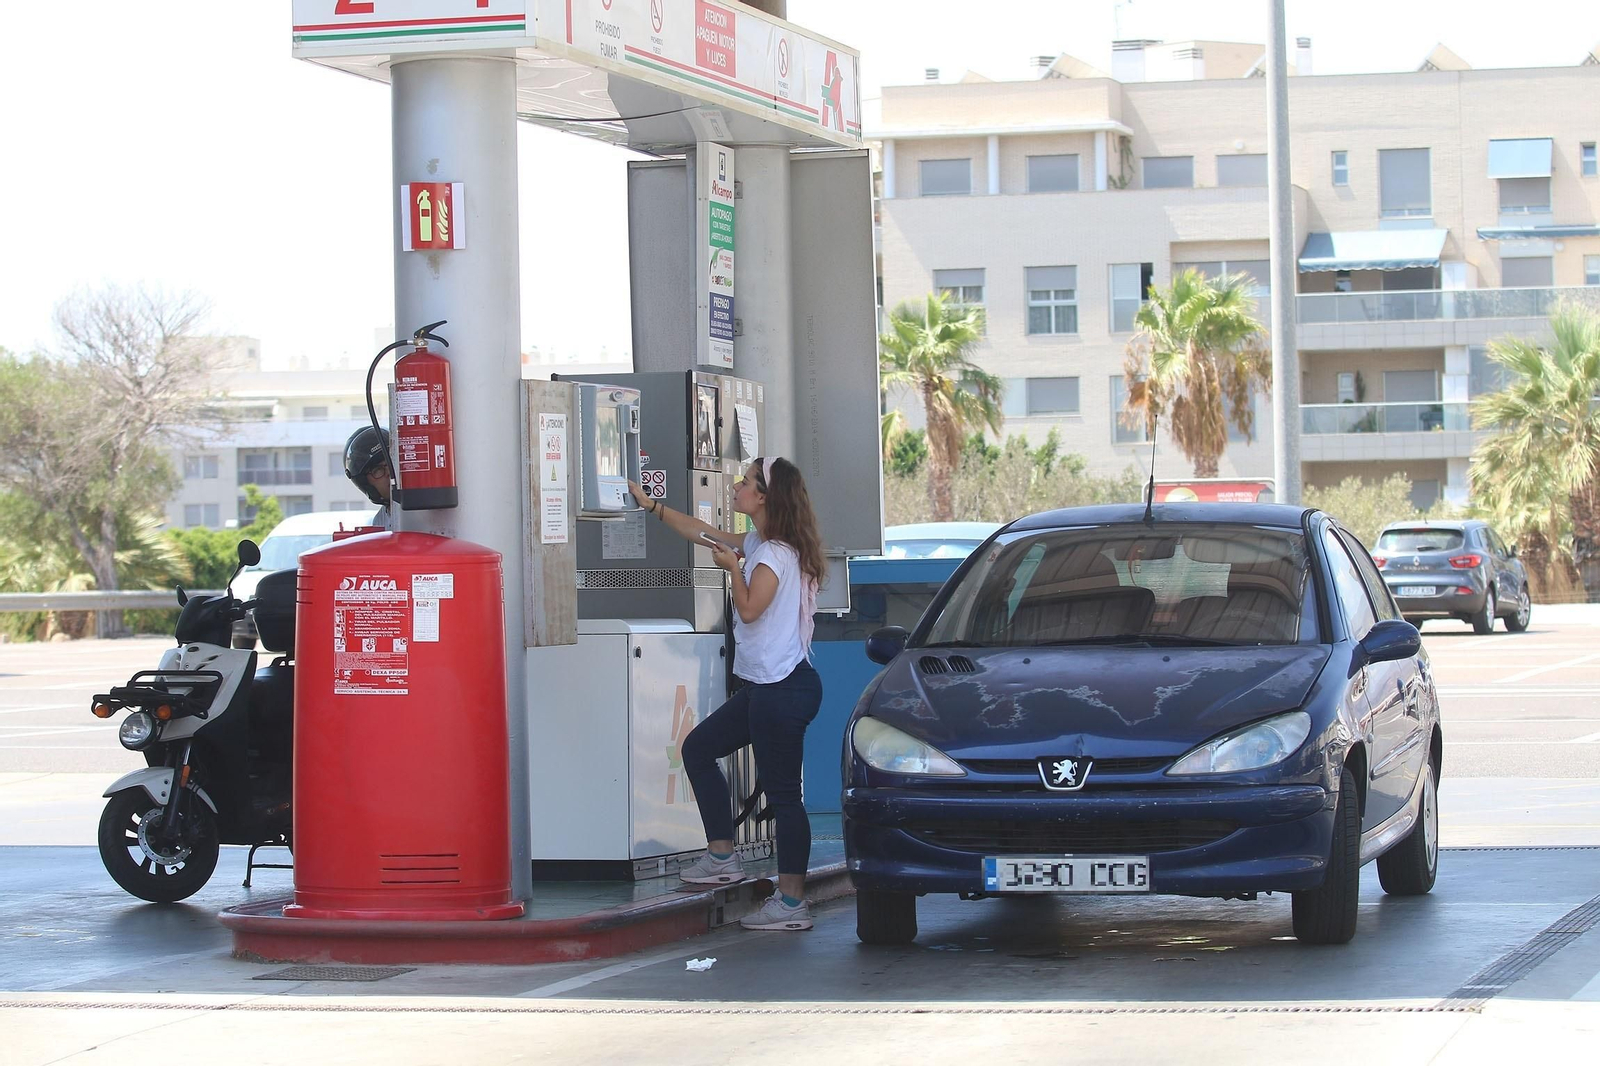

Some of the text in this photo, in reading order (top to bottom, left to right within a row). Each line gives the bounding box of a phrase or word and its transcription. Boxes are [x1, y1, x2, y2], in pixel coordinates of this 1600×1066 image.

[595, 20, 620, 39] PROHIBIDO
[696, 28, 735, 51] APAGUEN MOTOR
[600, 42, 618, 60] FUMAR
[706, 49, 726, 68] Y LUCES
[712, 180, 732, 200] Alcampo
[711, 207, 732, 222] AUTOPAGO
[713, 296, 730, 310] PREPAGO
[359, 580, 397, 590] AUCA
